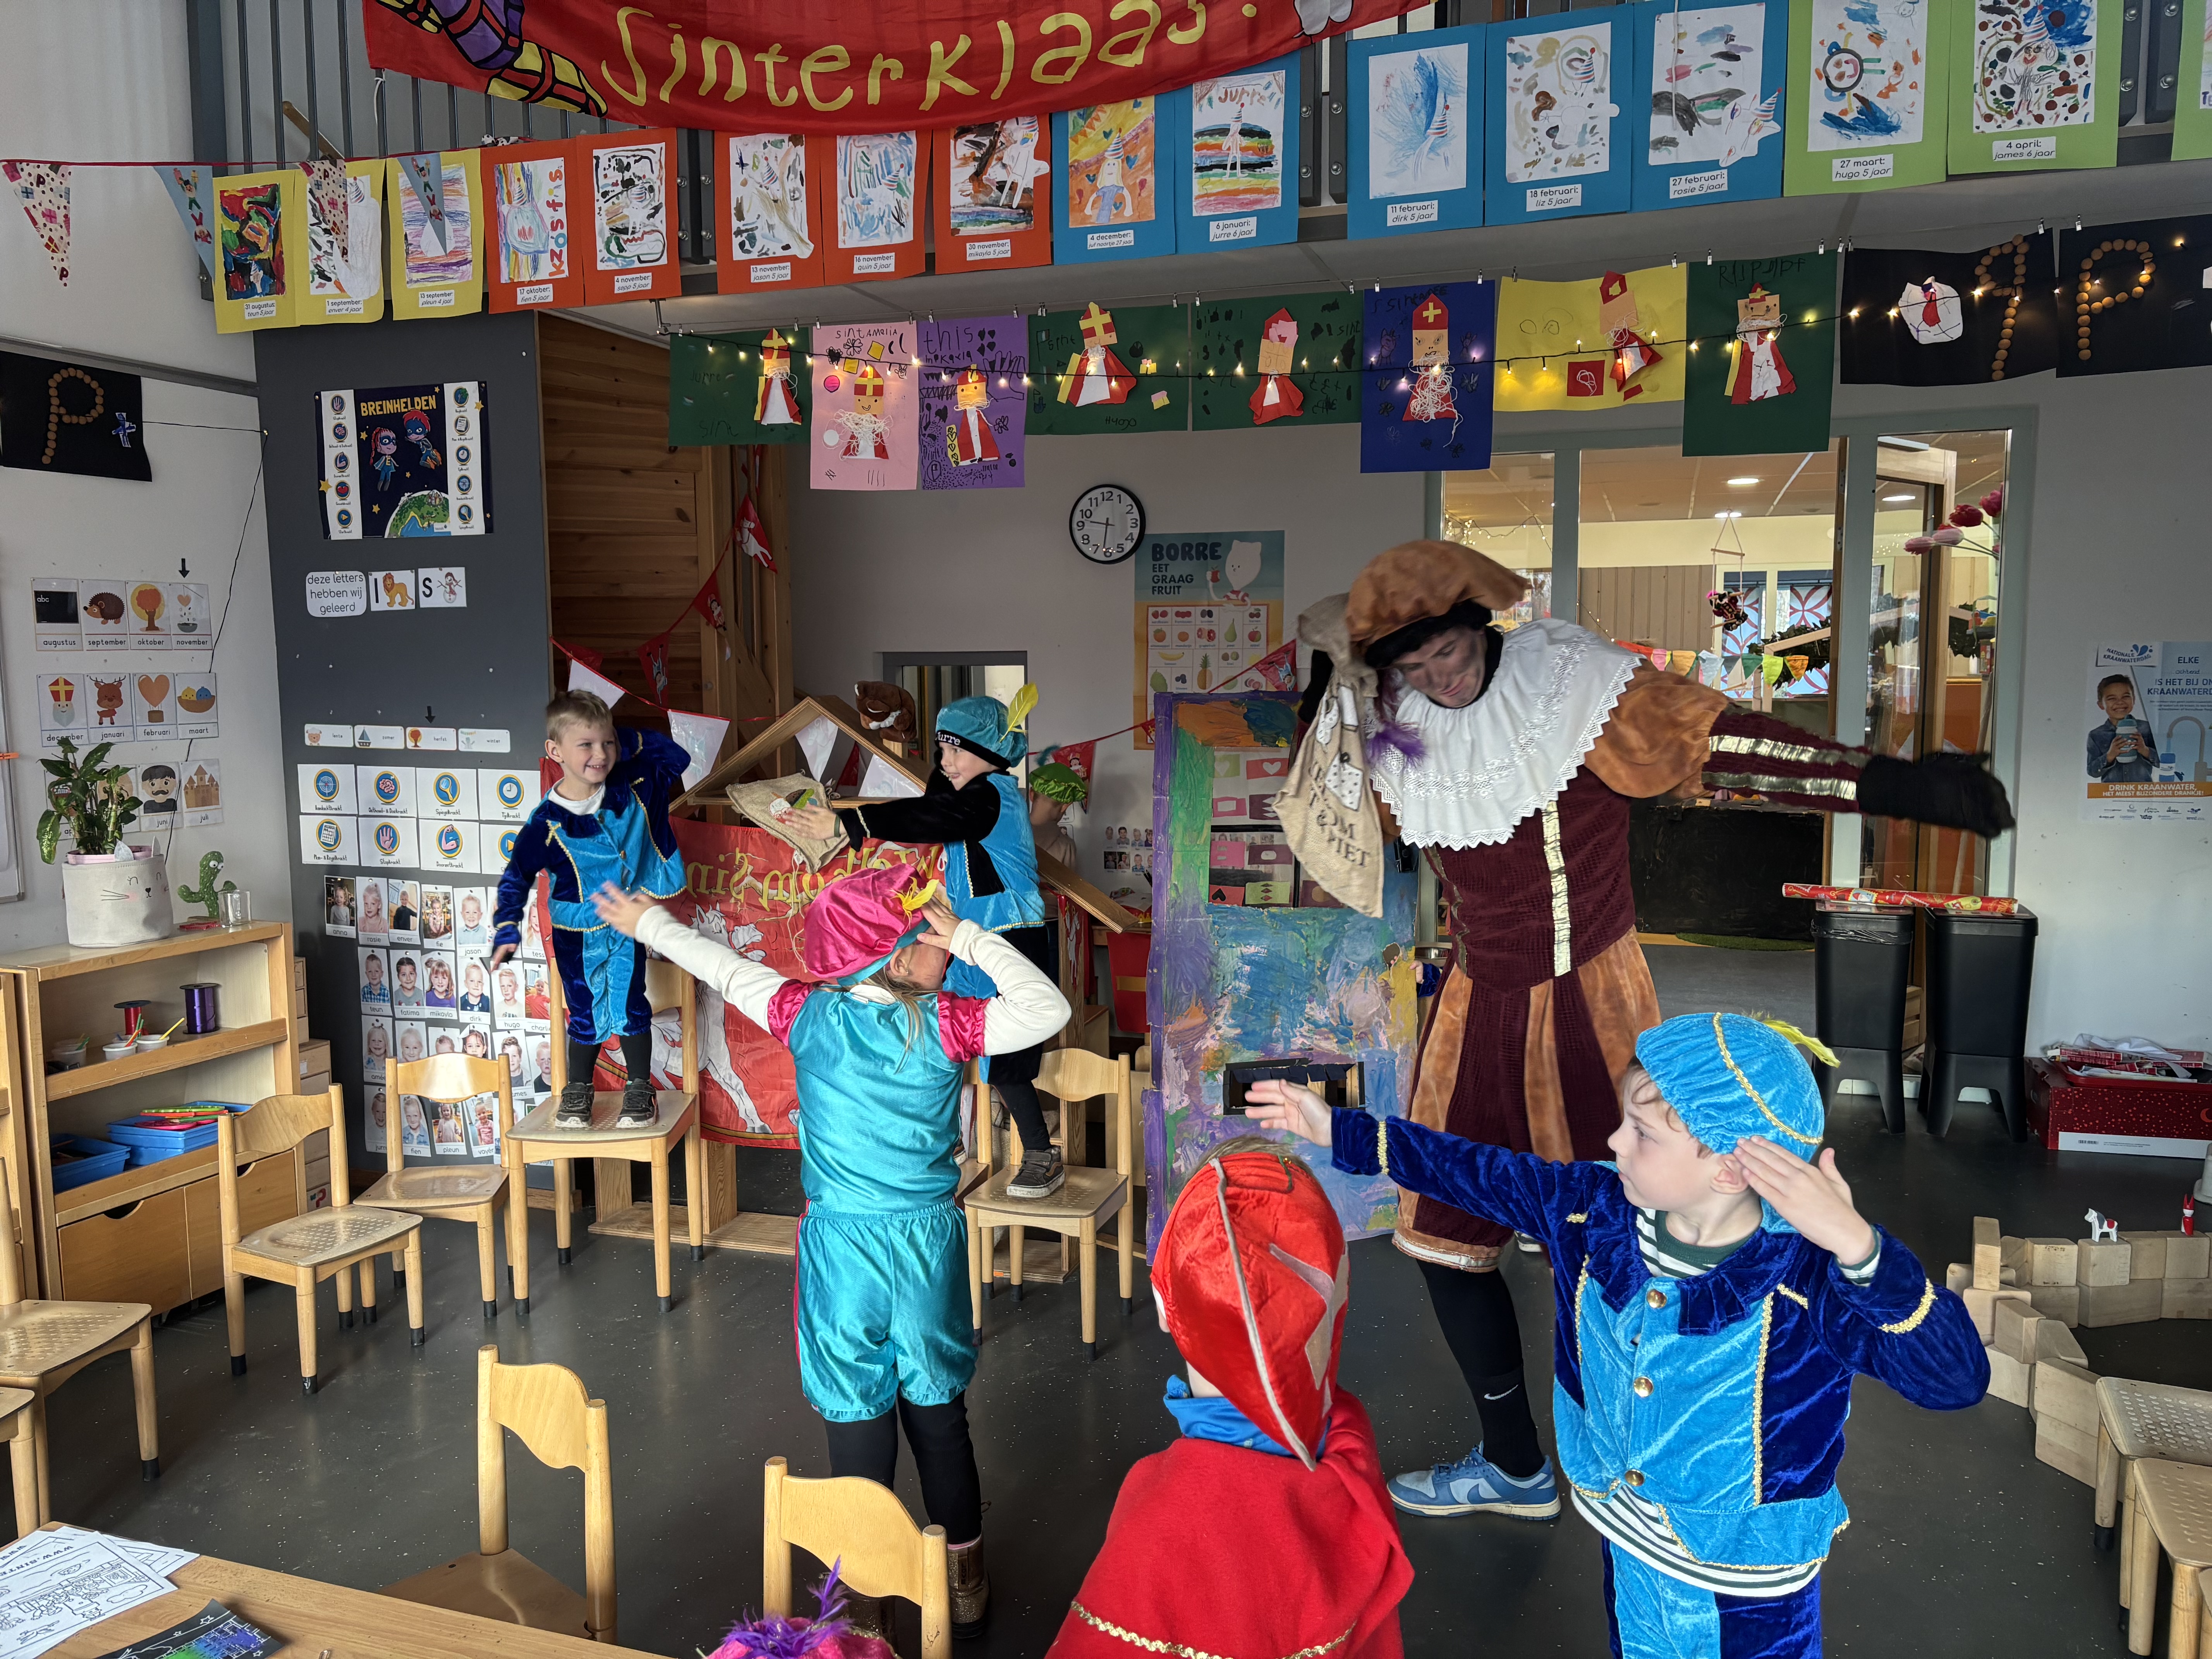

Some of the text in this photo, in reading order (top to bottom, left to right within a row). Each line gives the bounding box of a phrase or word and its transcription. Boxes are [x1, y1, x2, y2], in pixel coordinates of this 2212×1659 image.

[601, 0, 1257, 112] Sinterklaas
[2015, 141, 2041, 150] april:
[1993, 151, 2024, 160] james
[1840, 158, 1885, 168] 27 maart:
[1685, 172, 1725, 184] februari:
[1835, 171, 1860, 179] hugo
[1869, 168, 1891, 178] jaar
[1540, 186, 1578, 197] februari:
[1673, 187, 1696, 195] rosie
[1704, 182, 1725, 192] jaar
[1552, 197, 1573, 207] jaar
[1399, 202, 1435, 213] februari:
[1392, 214, 1408, 222] dirk
[1415, 212, 1434, 222] jaar
[1221, 220, 1251, 231] januari:
[1096, 232, 1130, 240] december:
[1211, 231, 1231, 241] jurre
[1237, 229, 1254, 238] jaar
[752, 273, 770, 282] jason
[776, 272, 789, 280] jaar
[360, 395, 436, 416] BREINHELDEN
[1100, 491, 1114, 502] 12
[1117, 494, 1121, 504] 1
[1088, 497, 1098, 507] 11
[1080, 509, 1092, 519] 10
[1126, 504, 1134, 514] 2
[1076, 521, 1085, 531] 9
[1130, 518, 1139, 528] 3
[1125, 532, 1135, 543] 4
[1116, 543, 1125, 553] 5
[1151, 542, 1222, 562] BORRE
[1152, 564, 1169, 573] EET
[307, 574, 364, 584] deze letters
[1152, 574, 1194, 584] GRAAG
[311, 587, 362, 599] hebben wij
[1152, 585, 1182, 595] FRUIT
[320, 602, 355, 615] geleerd
[43, 639, 76, 647] augustus
[88, 639, 126, 647] september
[2106, 647, 2135, 658] NATIONALE
[2103, 653, 2152, 663] KRAANWATERDAG
[101, 731, 125, 739] januari
[2138, 783, 2197, 792] KRAANWATER,
[157, 818, 168, 827] juni
[200, 813, 209, 823] juli
